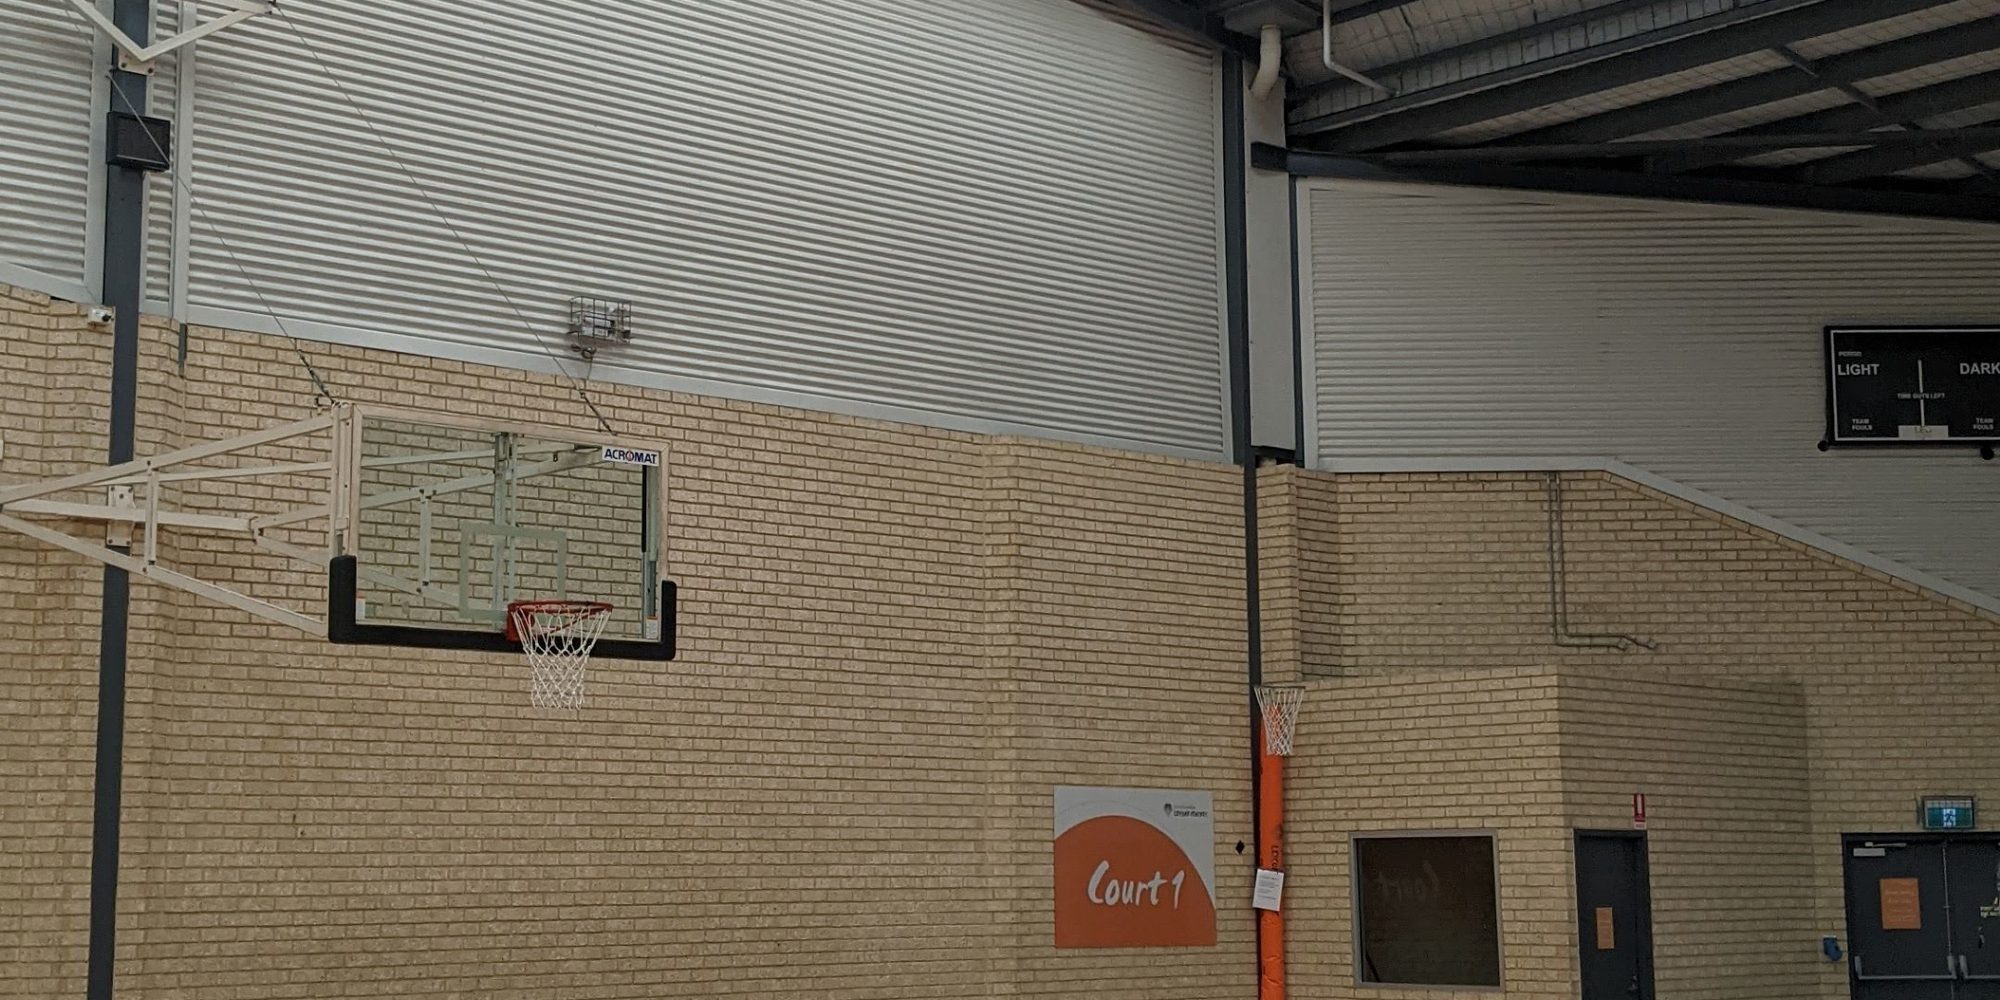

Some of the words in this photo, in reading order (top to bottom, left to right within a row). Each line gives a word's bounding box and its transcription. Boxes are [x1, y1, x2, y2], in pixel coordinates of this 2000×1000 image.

[1837, 363, 1880, 376] LIGHT
[1959, 362, 2000, 375] DARK
[604, 449, 657, 464] ACROMAT
[1087, 860, 1168, 906] Court
[1172, 869, 1185, 910] 1
